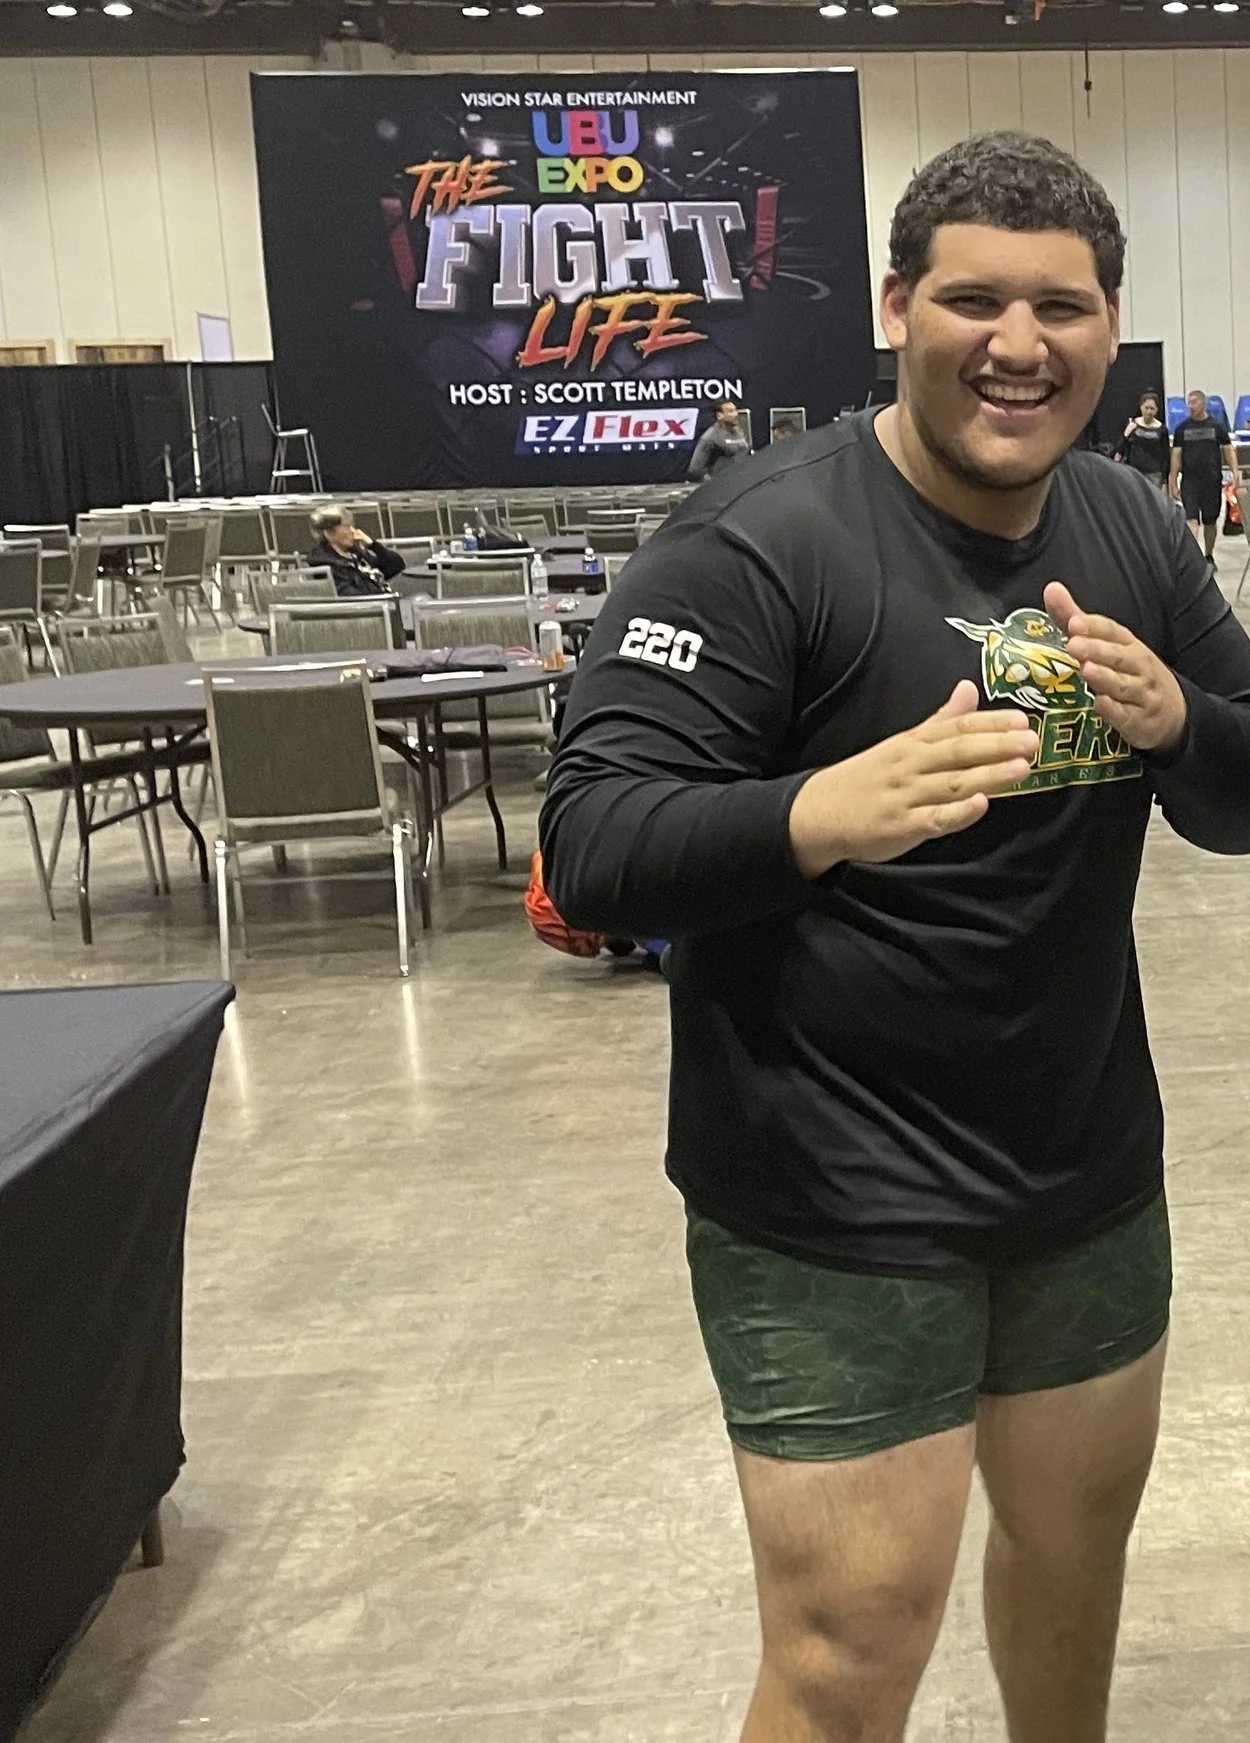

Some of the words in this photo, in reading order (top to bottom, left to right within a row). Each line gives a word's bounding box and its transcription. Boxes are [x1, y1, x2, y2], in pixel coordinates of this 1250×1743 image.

[461, 92, 519, 107] VISION
[524, 91, 563, 106] STAR
[566, 90, 697, 106] ENTERTAINMENT
[532, 110, 640, 156] UBU
[405, 154, 515, 220] THE
[536, 156, 644, 193] EXPO
[415, 201, 746, 310] FIGHT
[515, 291, 709, 373] LIFE
[450, 384, 513, 404] HOST
[534, 382, 605, 403] SCOTT
[611, 378, 743, 401] TEMPLETON
[524, 415, 580, 442] EZ
[592, 414, 689, 440] Flex
[618, 617, 704, 673] 220
